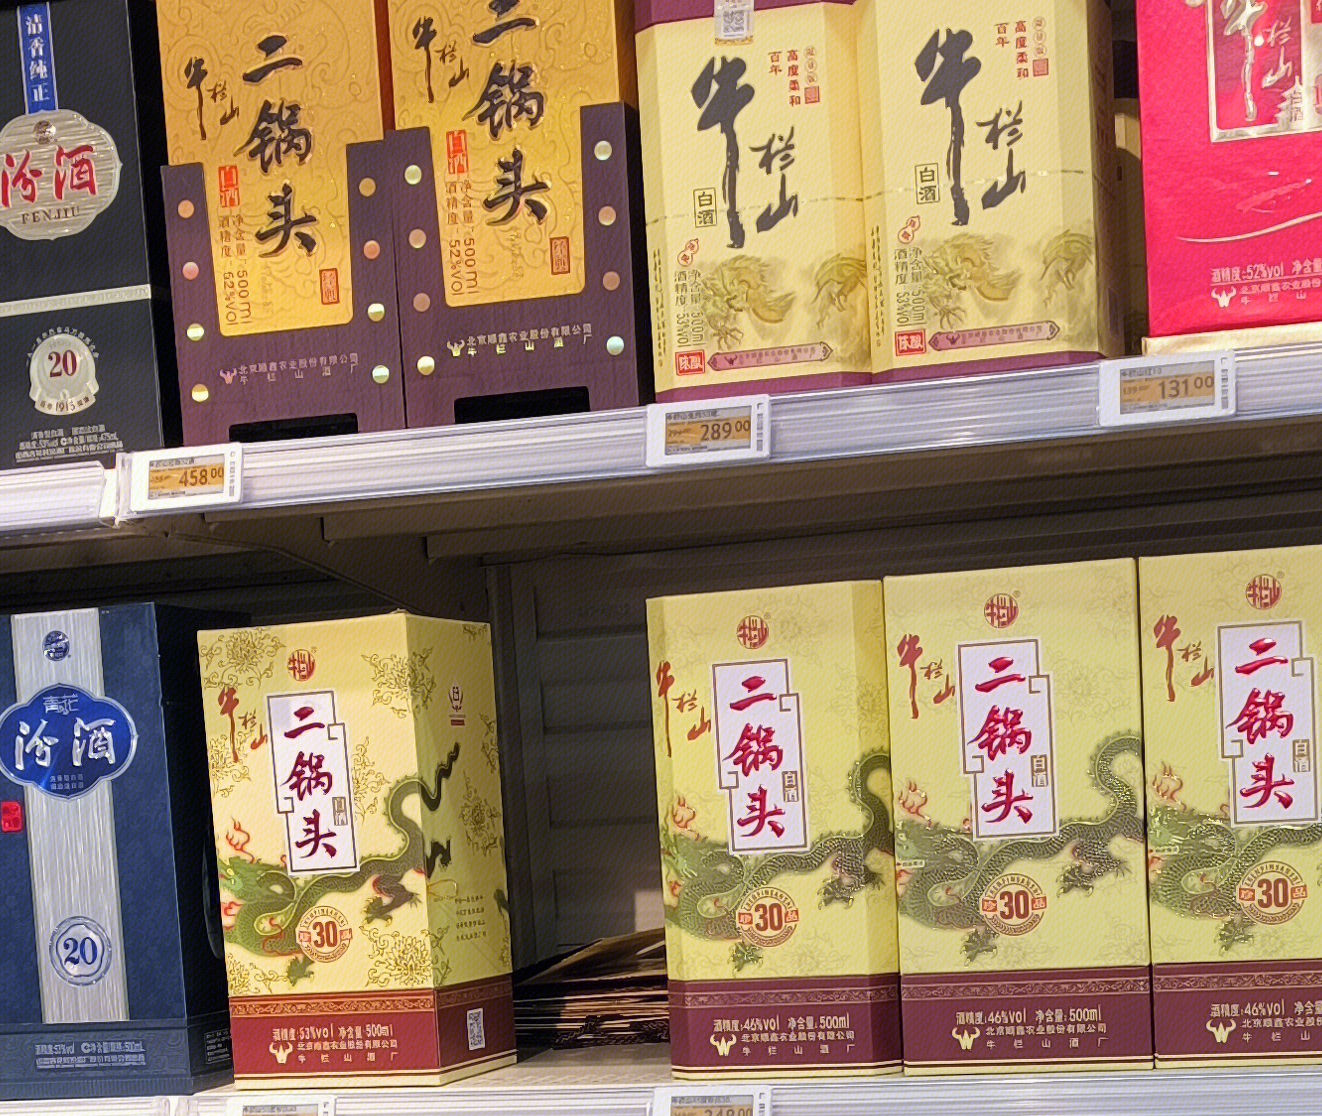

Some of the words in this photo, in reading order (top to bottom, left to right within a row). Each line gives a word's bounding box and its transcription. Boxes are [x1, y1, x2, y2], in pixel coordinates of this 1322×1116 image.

[994, 22, 1010, 48] 百年
[768, 50, 783, 76] 百年
[914, 28, 1027, 226] 牛栏山
[234, 34, 318, 259] 二锅头
[691, 56, 799, 249] 牛栏山
[0, 144, 97, 208] 汾酒
[919, 167, 938, 203] 白酒
[21, 206, 82, 224] FENJIU
[696, 192, 715, 225] 白酒
[47, 349, 78, 378] 20
[967, 656, 1034, 824] 二锅头
[1226, 637, 1295, 809] 二锅头
[14, 717, 117, 769] 汾酒
[722, 676, 786, 838] 二锅头
[279, 706, 338, 858] 二锅头
[999, 890, 1029, 919] 30
[1257, 878, 1289, 909] 30
[755, 903, 784, 932] 30
[63, 937, 98, 965] 20
[312, 921, 338, 949] 30
